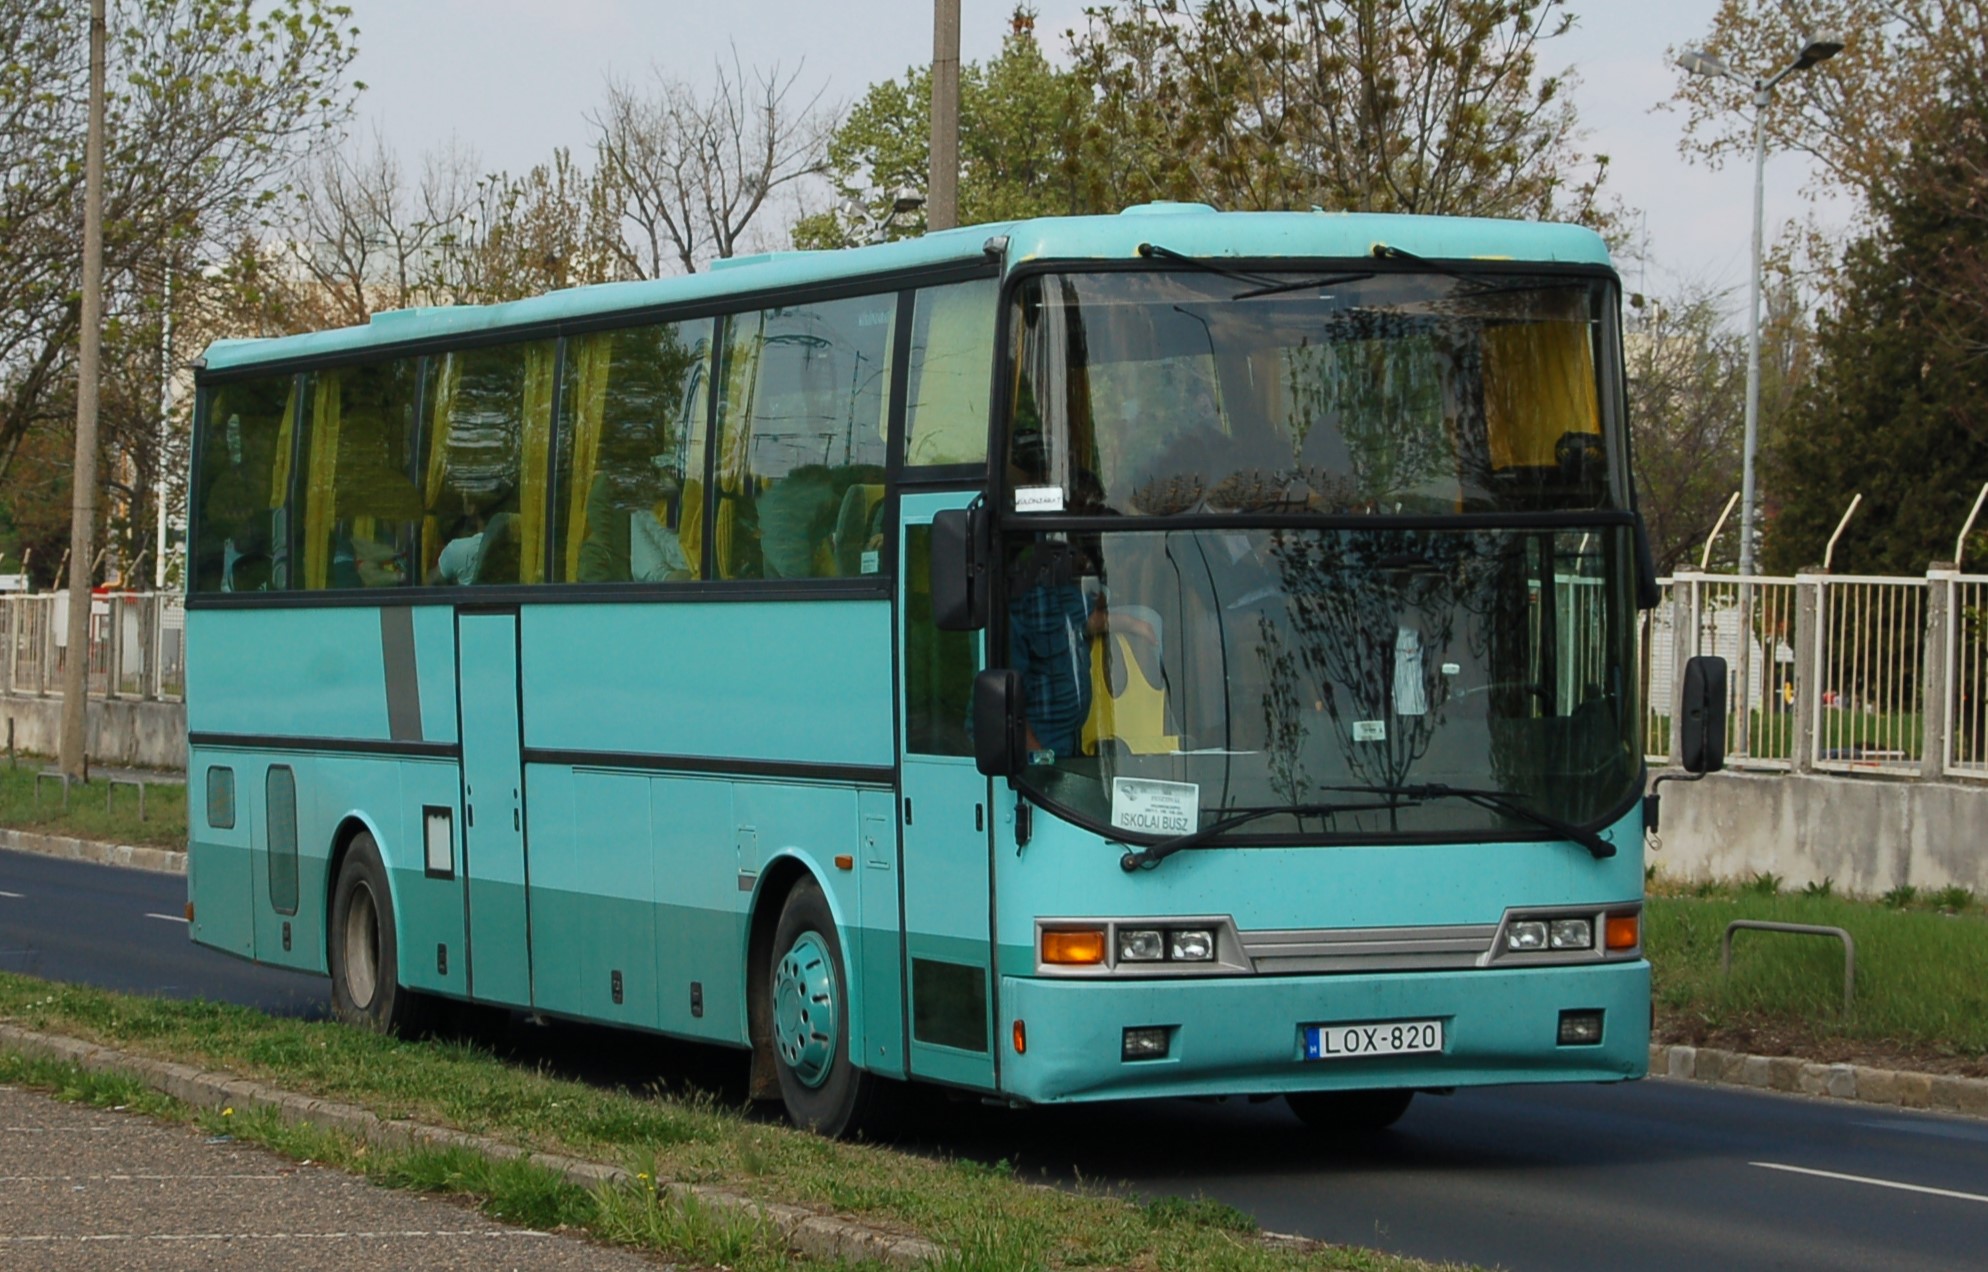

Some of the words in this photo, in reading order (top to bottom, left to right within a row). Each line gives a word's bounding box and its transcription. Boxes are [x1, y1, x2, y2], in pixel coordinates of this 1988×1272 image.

[1120, 812, 1160, 829] ISKOLAI
[1162, 816, 1188, 832] BUSZ
[1325, 1024, 1435, 1054] LOX-820
[1309, 1045, 1318, 1054] H
